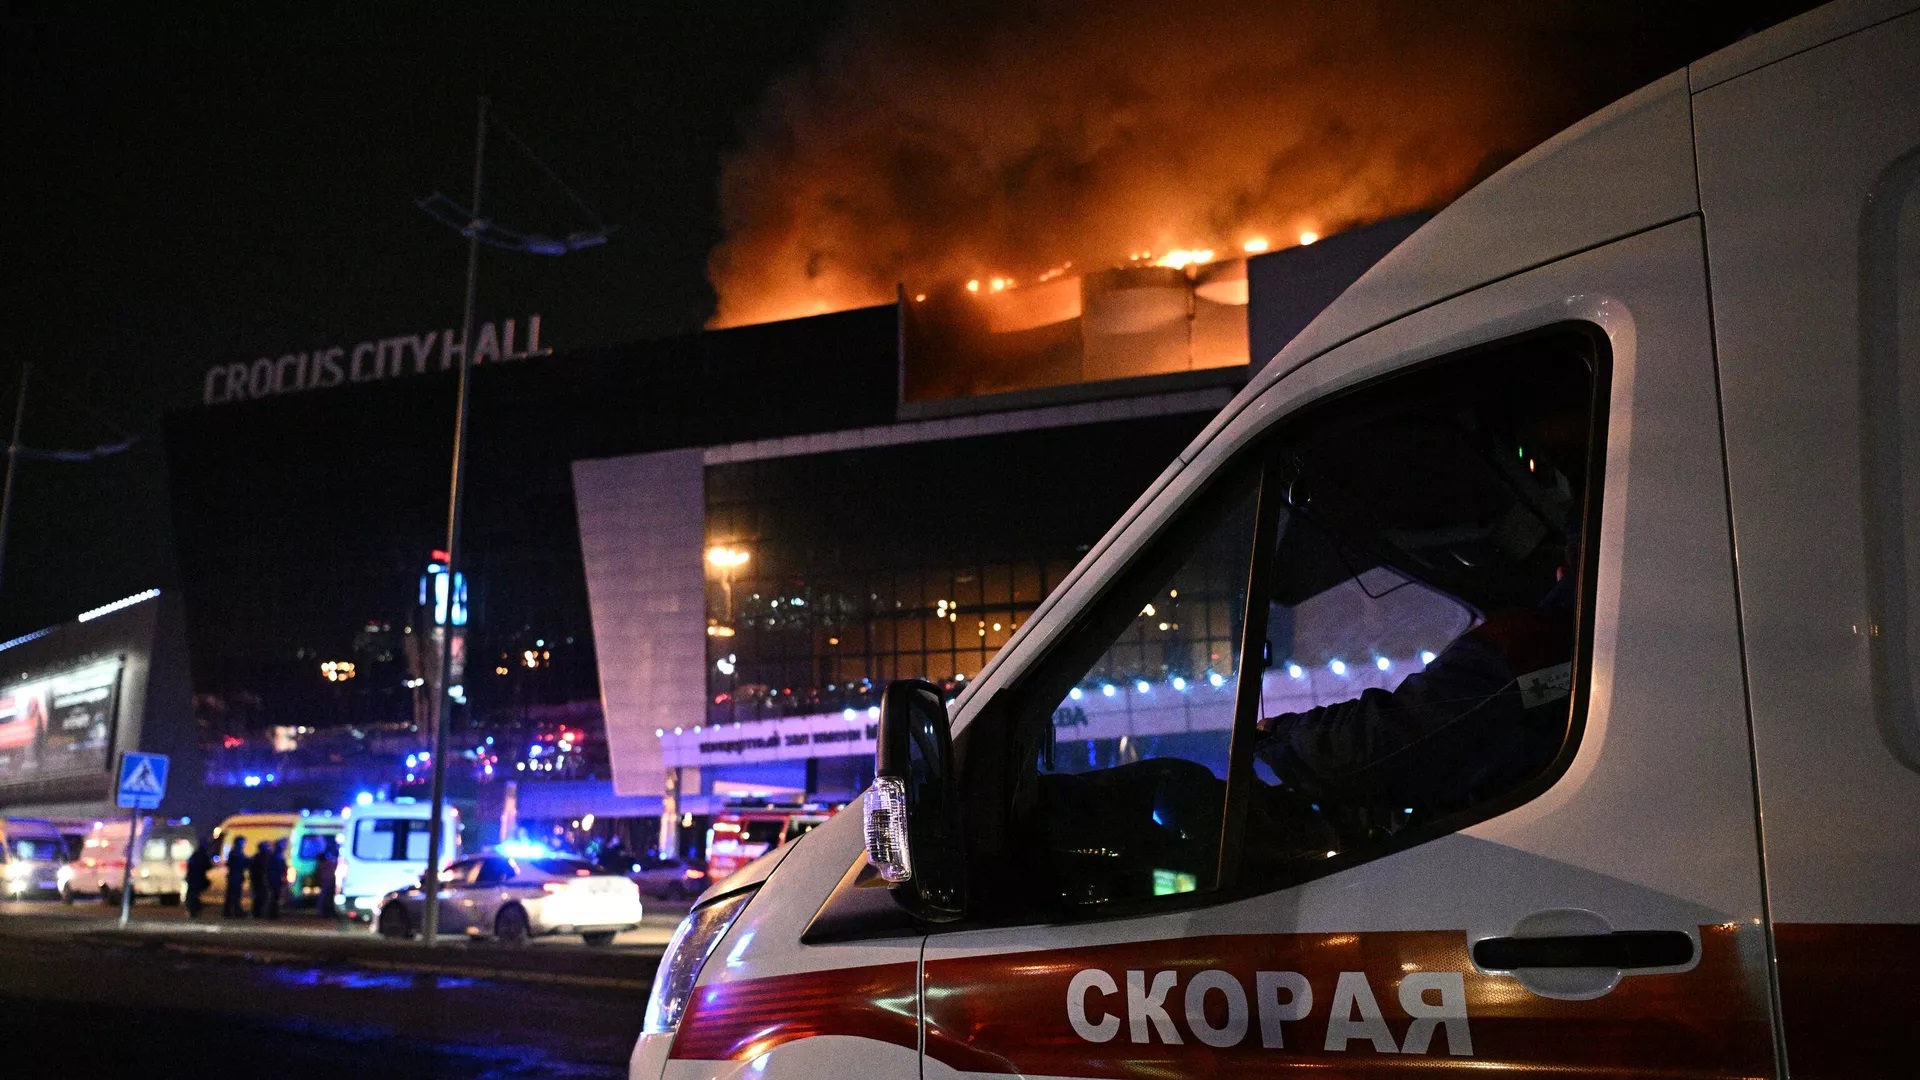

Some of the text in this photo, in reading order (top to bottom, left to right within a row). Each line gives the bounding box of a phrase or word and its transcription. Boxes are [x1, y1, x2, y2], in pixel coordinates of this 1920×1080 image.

[202, 313, 553, 406] CROCUS CITY HALL
[1066, 968, 1474, 1056] СКОРАЯ
